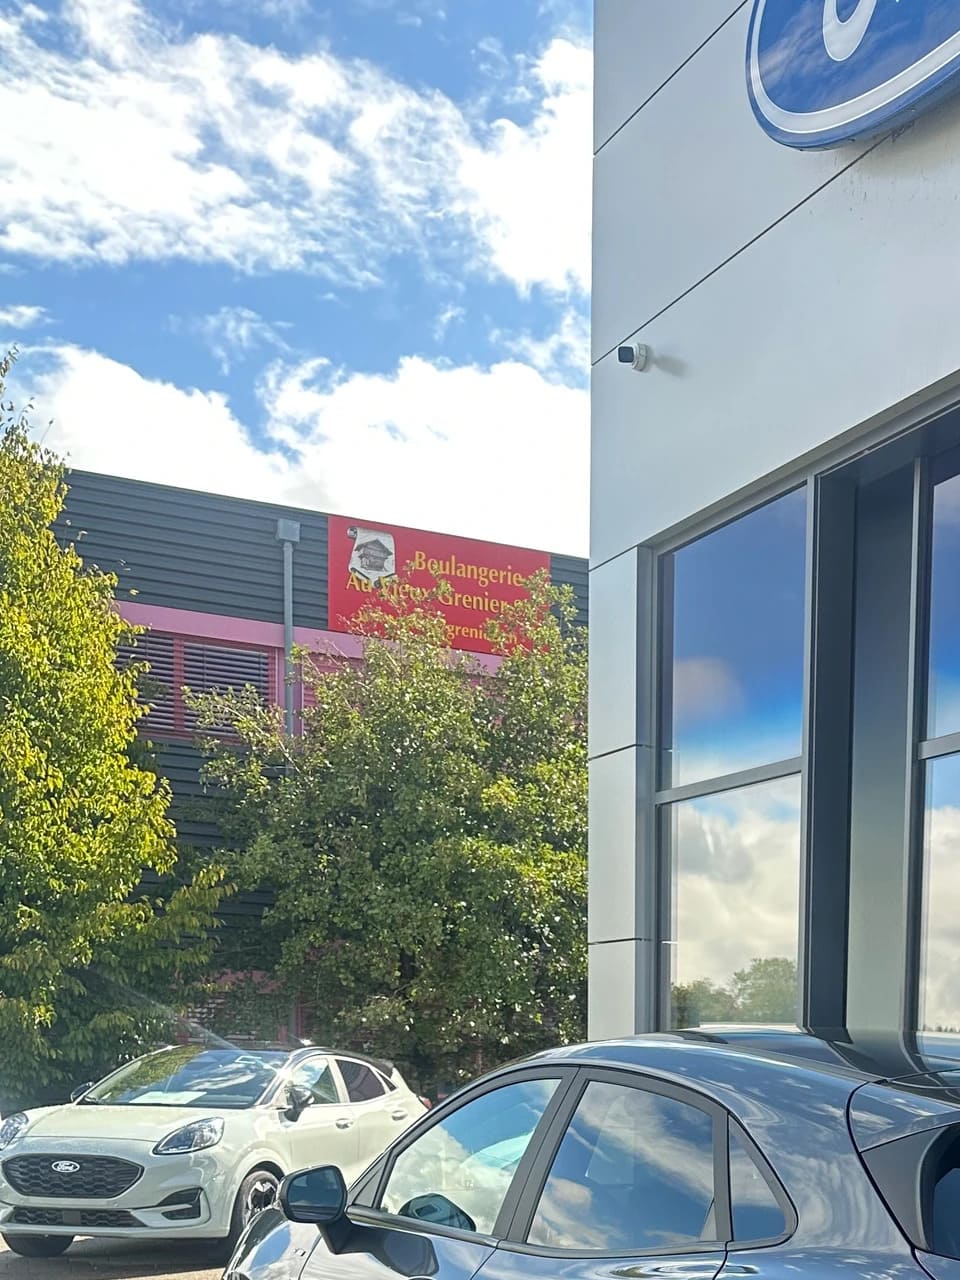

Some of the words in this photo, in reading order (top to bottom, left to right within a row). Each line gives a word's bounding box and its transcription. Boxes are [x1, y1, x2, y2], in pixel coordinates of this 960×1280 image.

[414, 551, 525, 588] Boulangerie
[346, 571, 372, 593] Au
[438, 587, 508, 614] Grenier
